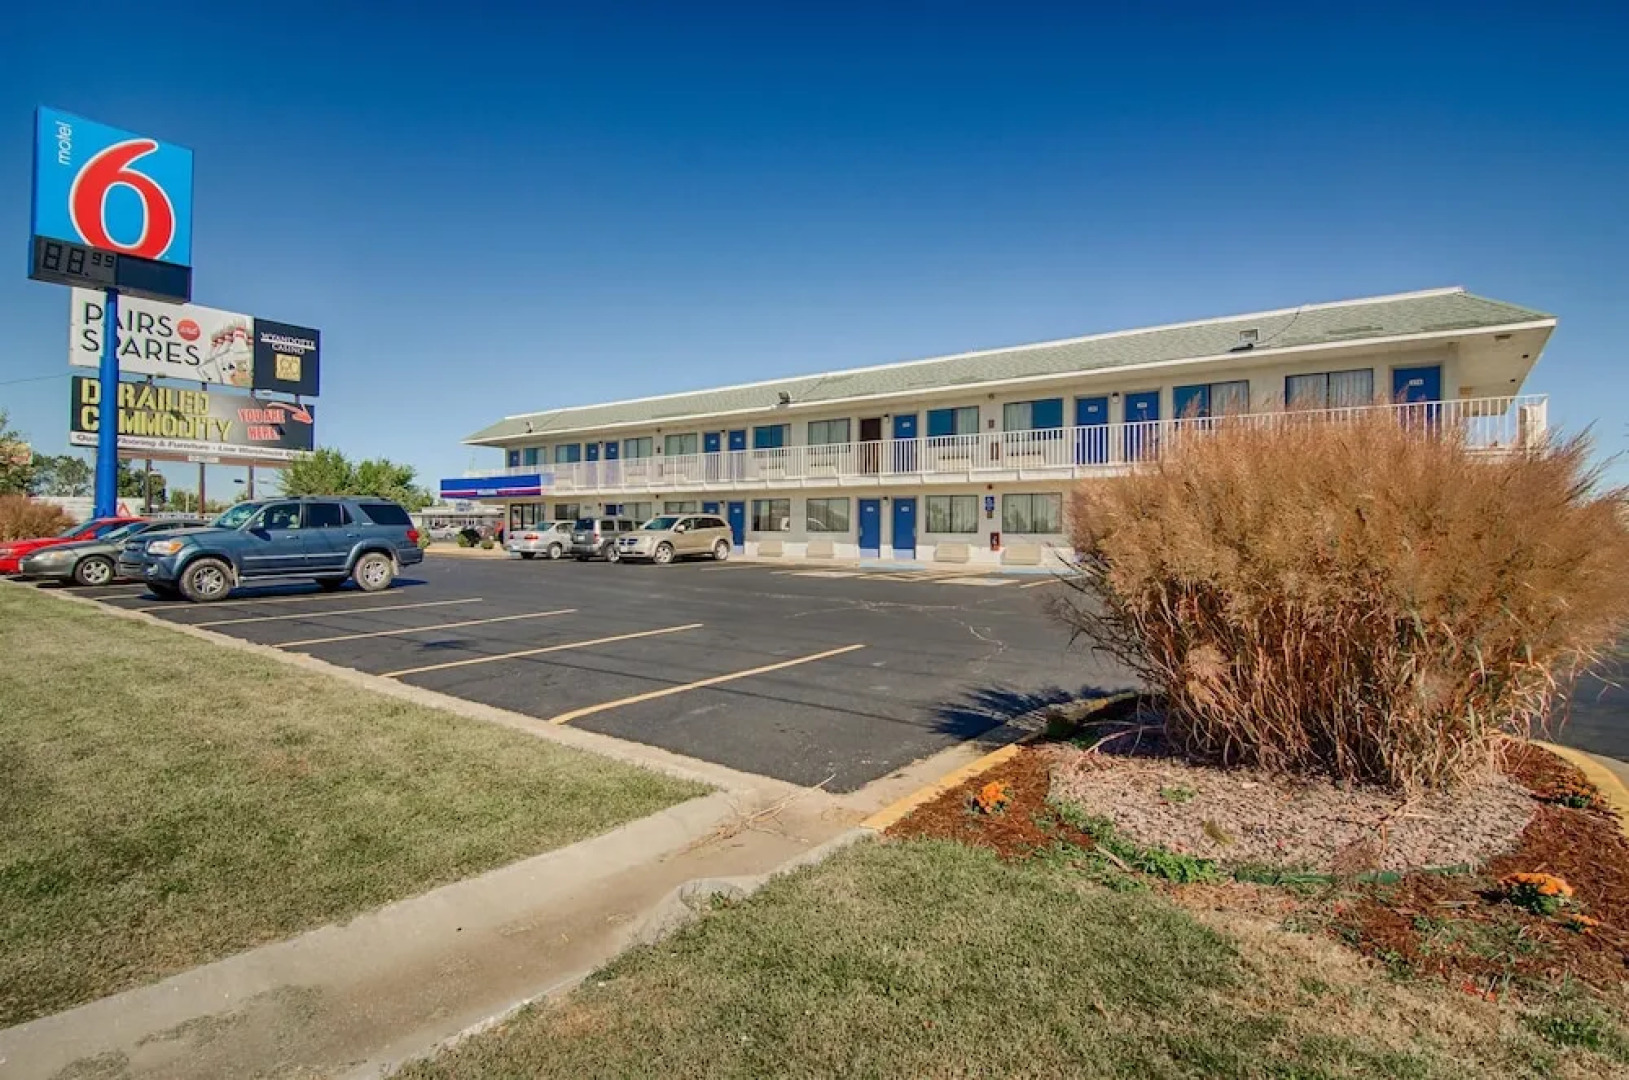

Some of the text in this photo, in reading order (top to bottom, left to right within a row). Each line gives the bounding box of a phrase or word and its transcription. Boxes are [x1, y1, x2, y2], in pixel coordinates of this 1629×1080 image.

[55, 121, 72, 165] motel
[68, 138, 176, 260] 6
[81, 329, 200, 366] SARES
[81, 378, 210, 416] DRAILED
[81, 404, 232, 442] CMMODITY
